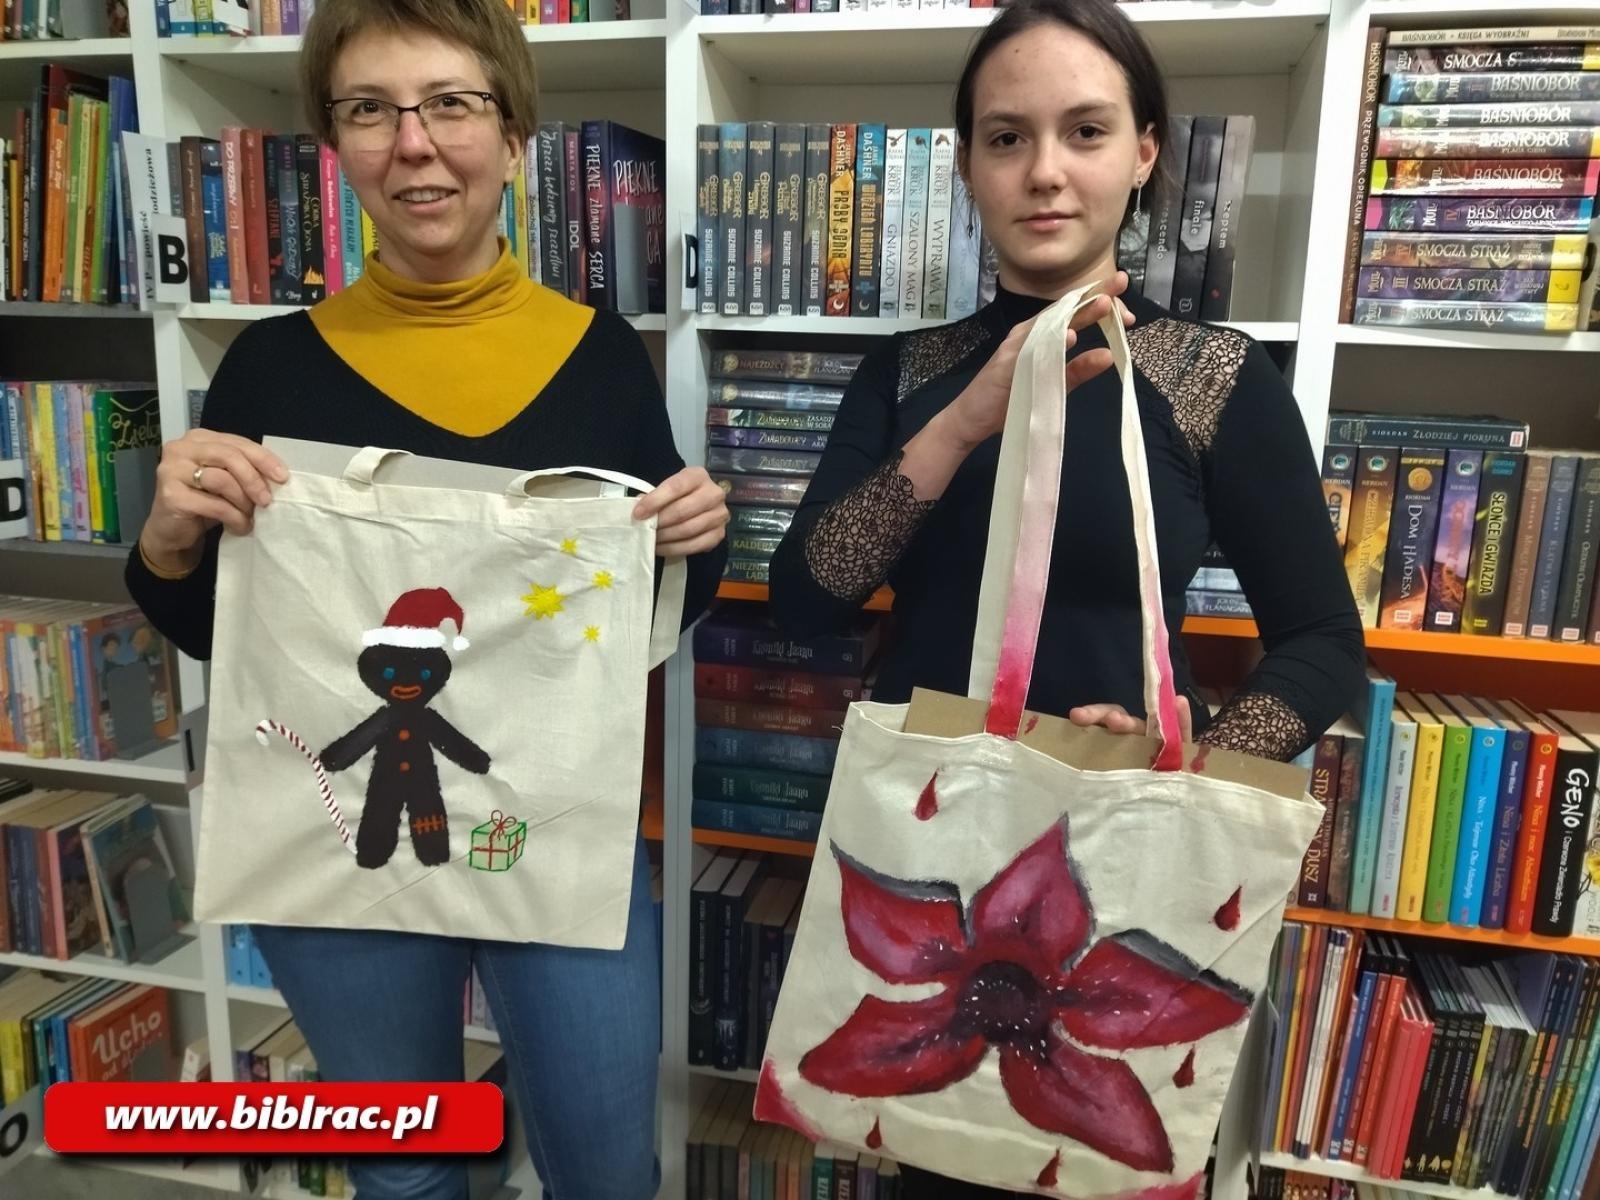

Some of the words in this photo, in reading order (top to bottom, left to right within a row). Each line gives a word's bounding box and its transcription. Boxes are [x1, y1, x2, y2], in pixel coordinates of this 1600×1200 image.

[1458, 32, 1482, 40] KSIĘGA
[1444, 53, 1502, 69] SMOCZA
[1491, 75, 1581, 91] BAŚNIOBÓR
[225, 141, 235, 159] DO
[835, 131, 845, 178] DASHNER
[862, 132, 873, 179] DASHNER
[1357, 110, 1371, 176] PRZEWODNIK
[888, 165, 896, 195] KRUK
[910, 166, 919, 196] KRUK
[1474, 166, 1563, 181] BAŚNIOBÓR
[709, 175, 719, 217] GREGOR
[732, 171, 743, 218] GREGOR
[759, 172, 771, 220] GREGOR
[789, 174, 800, 222] GREGOR
[816, 173, 828, 220] GREGOR
[833, 190, 850, 223] PRÓBY
[1354, 178, 1365, 226] OPIEKUNA
[1466, 201, 1556, 219] BAŚNIOBÓR
[1191, 200, 1205, 234] finale
[1219, 200, 1232, 249] szeptem
[140, 210, 153, 259] powieść
[569, 220, 579, 251] IDOL
[704, 229, 713, 263] SUZANNE
[727, 229, 736, 263] SUZANNE
[753, 229, 762, 264] SUZANNE
[782, 231, 791, 266] SUZANNE
[810, 230, 820, 265] SUZANNE
[833, 228, 848, 259] OGNIA
[907, 211, 921, 268] SZALONY
[158, 234, 189, 284] B
[589, 251, 604, 289] SERCA
[885, 224, 898, 287] GNIAZDO
[929, 219, 945, 296] WYPRAWA
[1416, 244, 1466, 258] SMOCZA
[1471, 244, 1511, 262] STRAŻ
[727, 266, 736, 297] COLLINS
[753, 267, 762, 298] COLLINS
[781, 268, 791, 300] COLLINS
[810, 267, 819, 299] COLLINS
[906, 271, 917, 301] MAG
[1414, 277, 1463, 290] SMOCZA
[1468, 277, 1507, 294] STRAŻ
[1413, 307, 1461, 321] SMOCZA
[1466, 307, 1504, 328] STRAŻ
[1413, 430, 1458, 441] ZŁODZIEJ
[1463, 433, 1505, 443] PIORUNA
[0, 477, 28, 523] D
[1407, 504, 1423, 539] DOM
[1400, 545, 1416, 599] HADESA
[1479, 543, 1498, 595] GWIAZDA
[1535, 780, 1544, 798] Witcher
[1536, 764, 1546, 780] Moony
[1559, 768, 1590, 828] GENO
[1501, 806, 1514, 828] Nina
[1531, 805, 1543, 826] Nina
[1527, 835, 1536, 853] moc
[1560, 836, 1572, 867] Czerwone
[1304, 849, 1320, 883] DUSZ
[1549, 901, 1562, 923] Prawdy
[92, 1011, 162, 1064] Ucho
